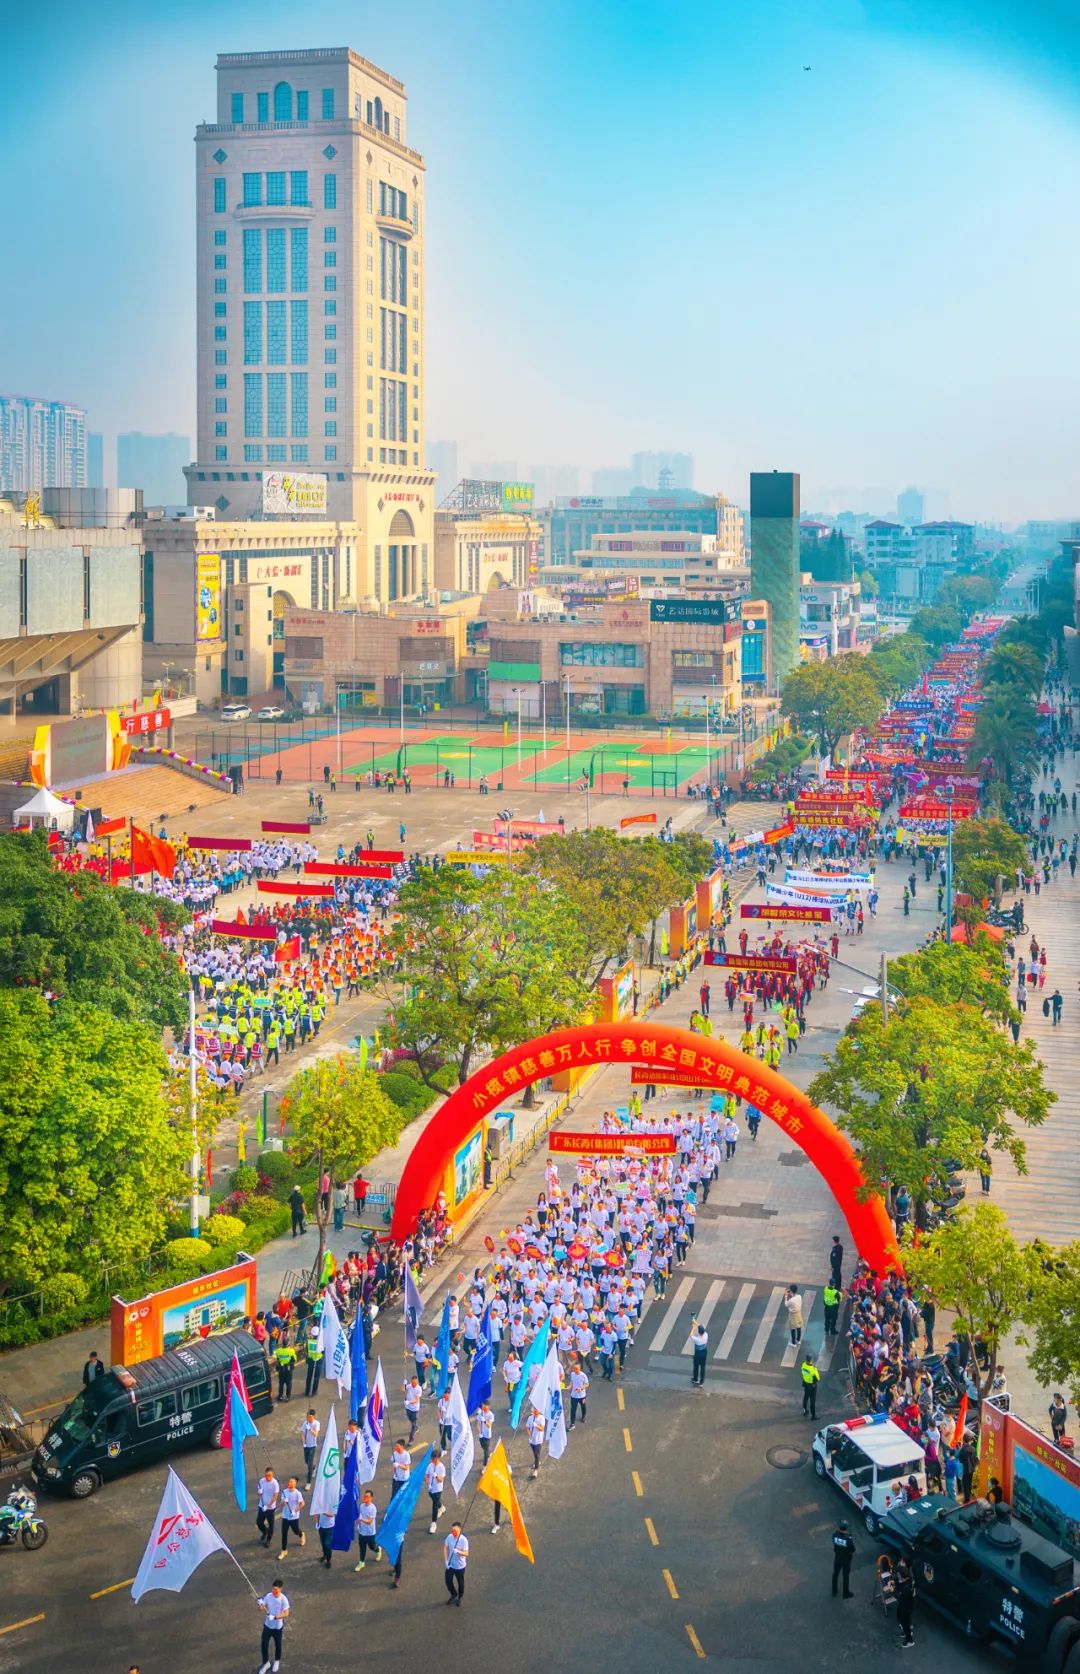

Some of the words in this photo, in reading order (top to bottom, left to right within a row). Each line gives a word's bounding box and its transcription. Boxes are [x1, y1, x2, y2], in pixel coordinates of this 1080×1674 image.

[126, 713, 163, 734] 行慈善
[169, 1411, 192, 1428] 特警
[166, 1425, 194, 1441] POLICE
[1001, 1597, 1024, 1623] 特警
[999, 1613, 1025, 1640] POLICE
